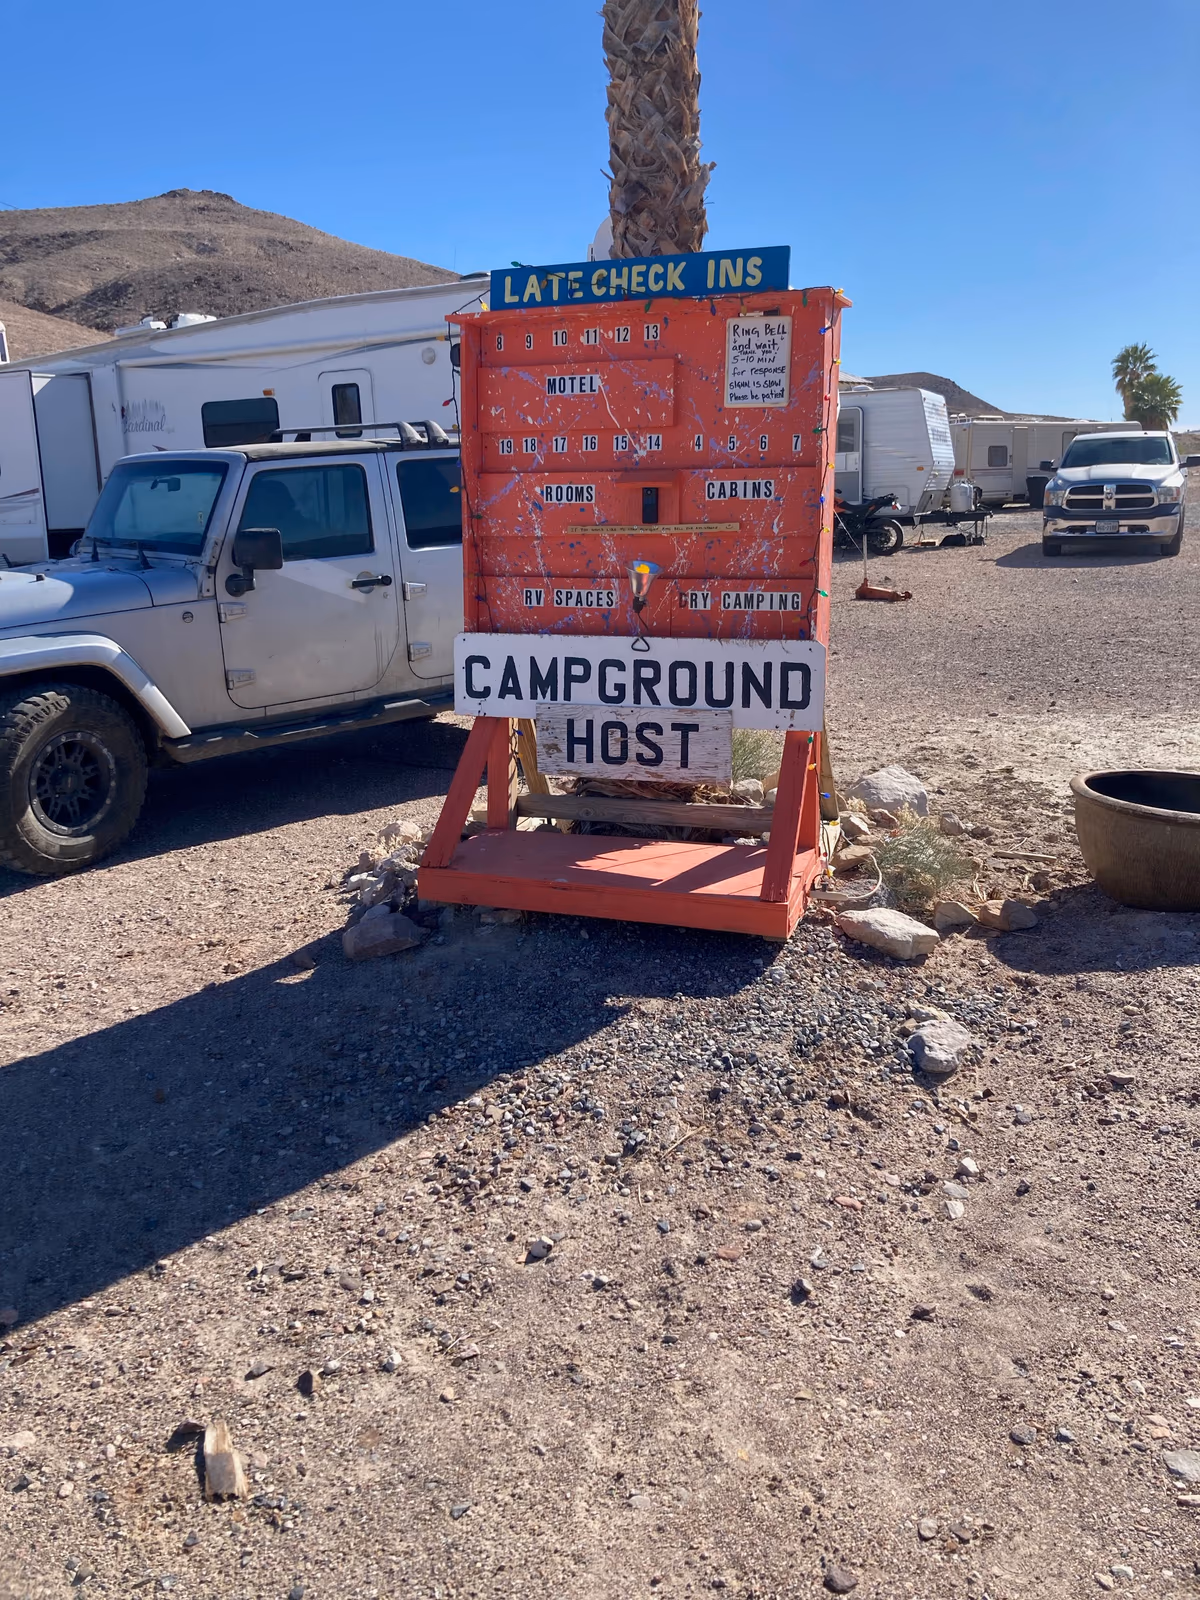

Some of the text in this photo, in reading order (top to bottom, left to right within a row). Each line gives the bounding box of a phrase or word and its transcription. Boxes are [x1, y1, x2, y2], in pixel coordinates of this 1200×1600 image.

[504, 256, 763, 303] LATE CHECK INS
[585, 329, 598, 345] 11
[616, 327, 629, 342] 12
[645, 324, 659, 340] 13
[732, 323, 787, 337] RING BELL
[496, 336, 503, 351] 8
[526, 334, 532, 349] 9
[553, 330, 567, 346] 10
[732, 338, 751, 351] and
[732, 355, 776, 364] 5-10 MIN
[732, 367, 746, 377] for
[547, 376, 597, 394] MOTEL
[750, 390, 759, 400] be
[500, 439, 513, 454] 19
[524, 438, 536, 452] 18
[554, 437, 567, 451] 17
[584, 436, 596, 450] 16
[614, 435, 628, 450] 15
[648, 435, 661, 449] 14
[695, 435, 701, 450] 4
[729, 436, 735, 450] 5
[760, 435, 767, 450] 6
[793, 435, 800, 450] 7
[545, 485, 593, 502] ROOMS
[707, 481, 772, 499] CABINS
[525, 589, 614, 607] RV SPACES
[679, 591, 800, 610] DRY CAMPING
[464, 654, 812, 710] CAMPGROUND
[566, 718, 700, 769] HOST
